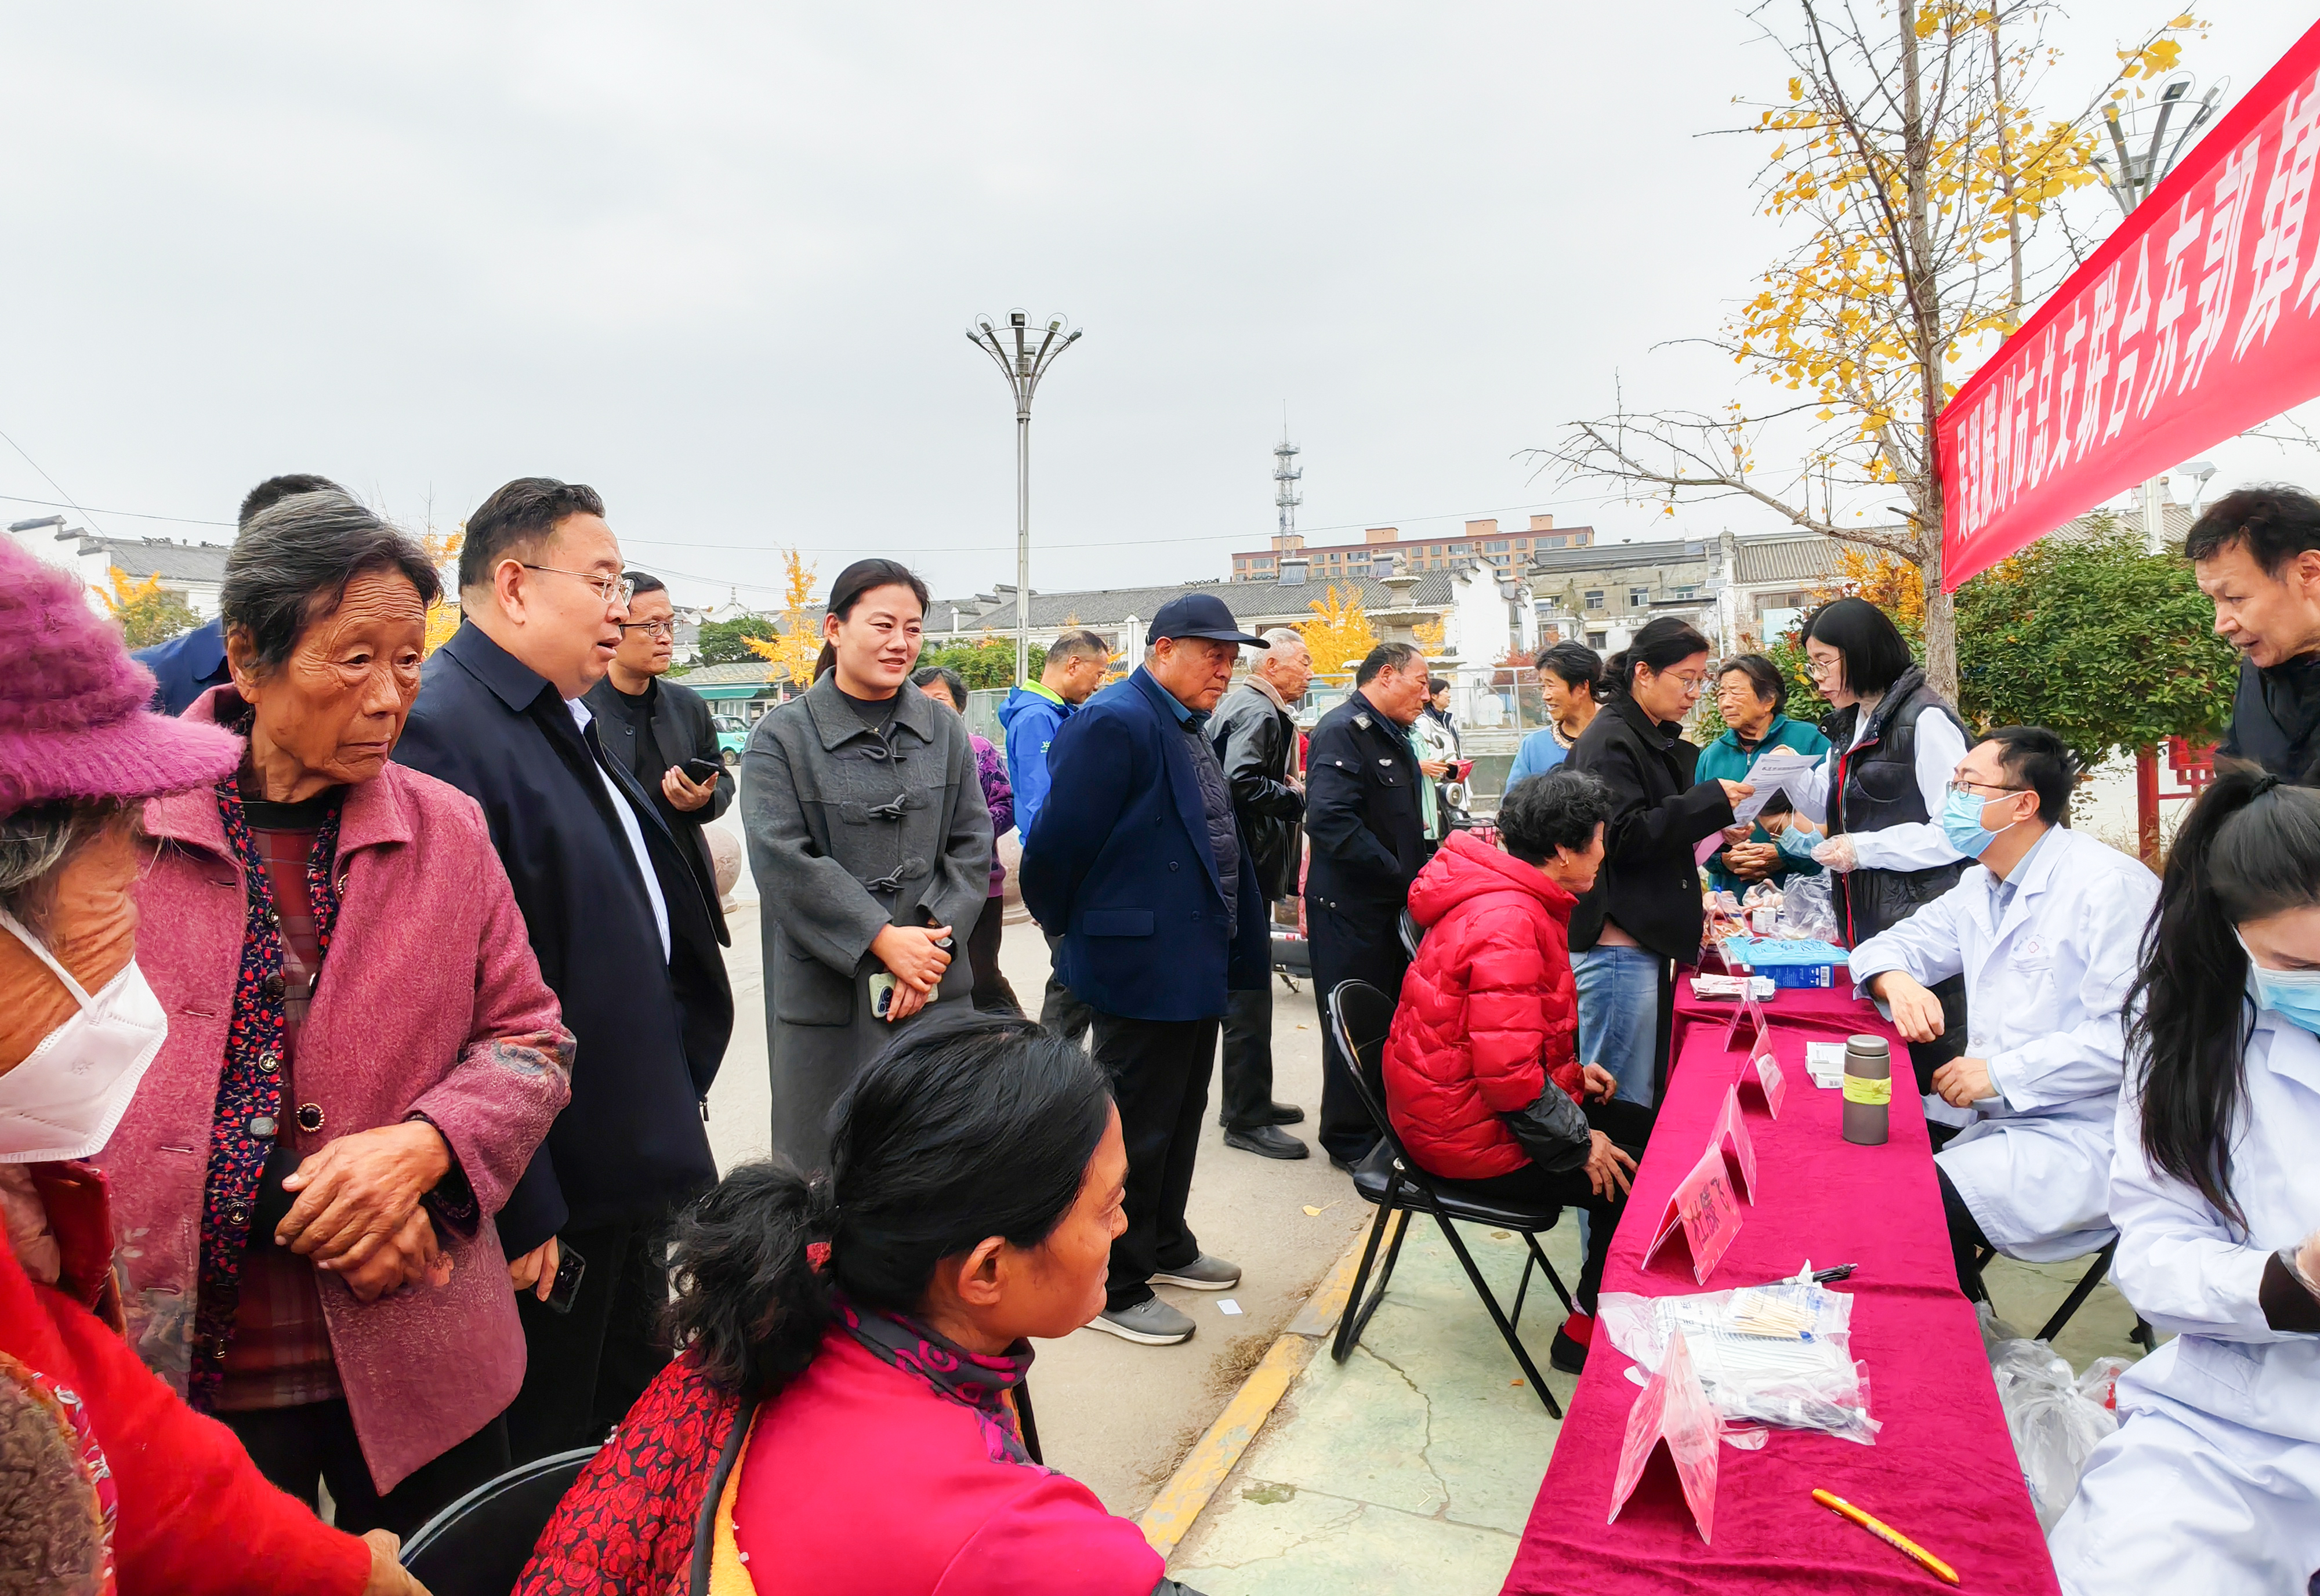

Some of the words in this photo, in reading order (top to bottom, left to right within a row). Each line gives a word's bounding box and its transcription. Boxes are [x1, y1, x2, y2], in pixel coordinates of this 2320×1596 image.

[1957, 67, 2320, 545] 民盟滕州市总支联合东郭镇
